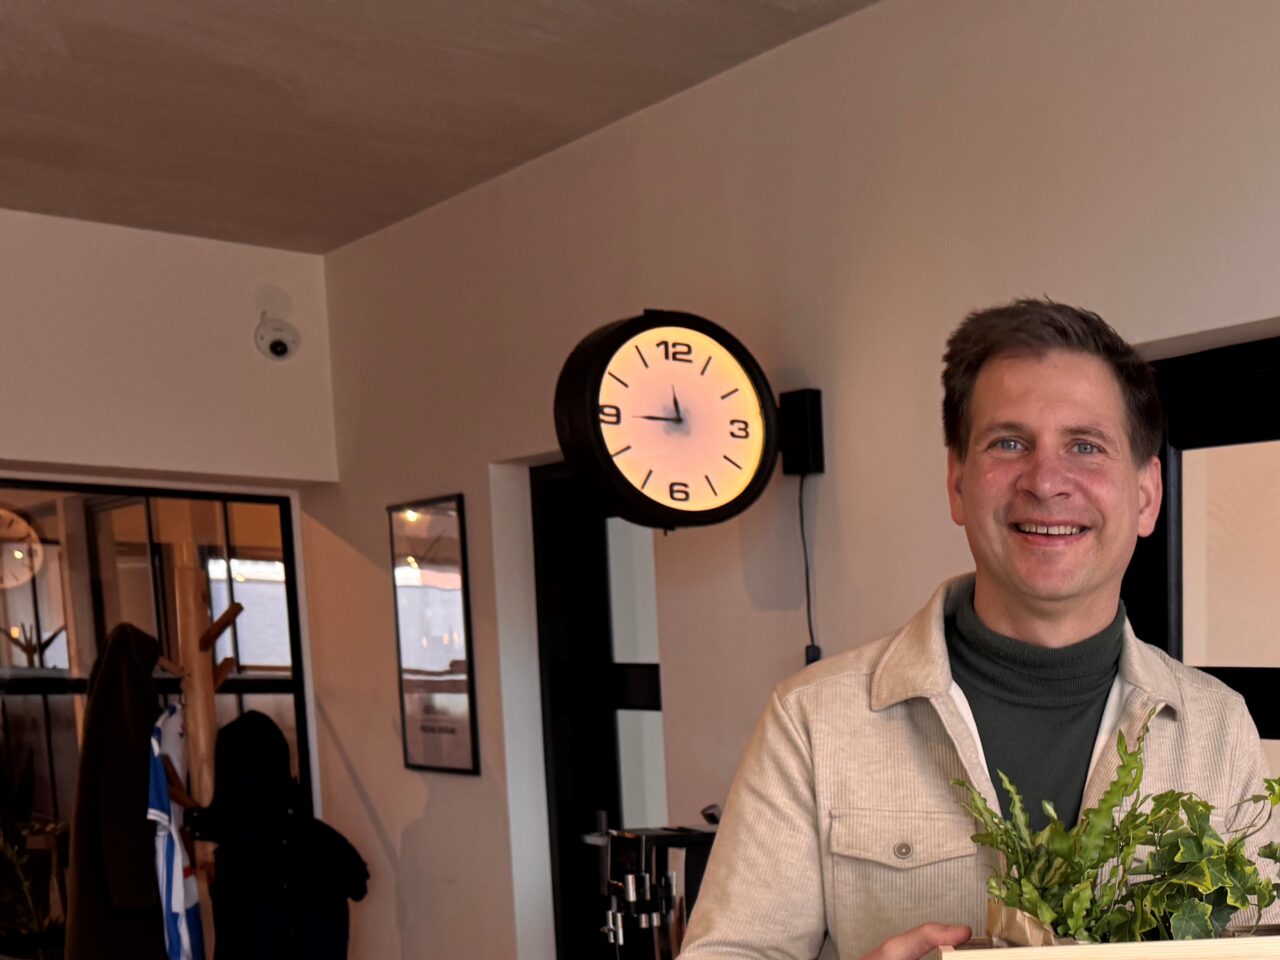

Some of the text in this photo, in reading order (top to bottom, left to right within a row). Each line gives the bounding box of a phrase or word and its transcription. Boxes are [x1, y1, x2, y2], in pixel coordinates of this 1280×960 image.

[656, 340, 693, 363] 12
[599, 404, 621, 425] 9
[729, 419, 750, 439] 3
[669, 482, 690, 502] 6
